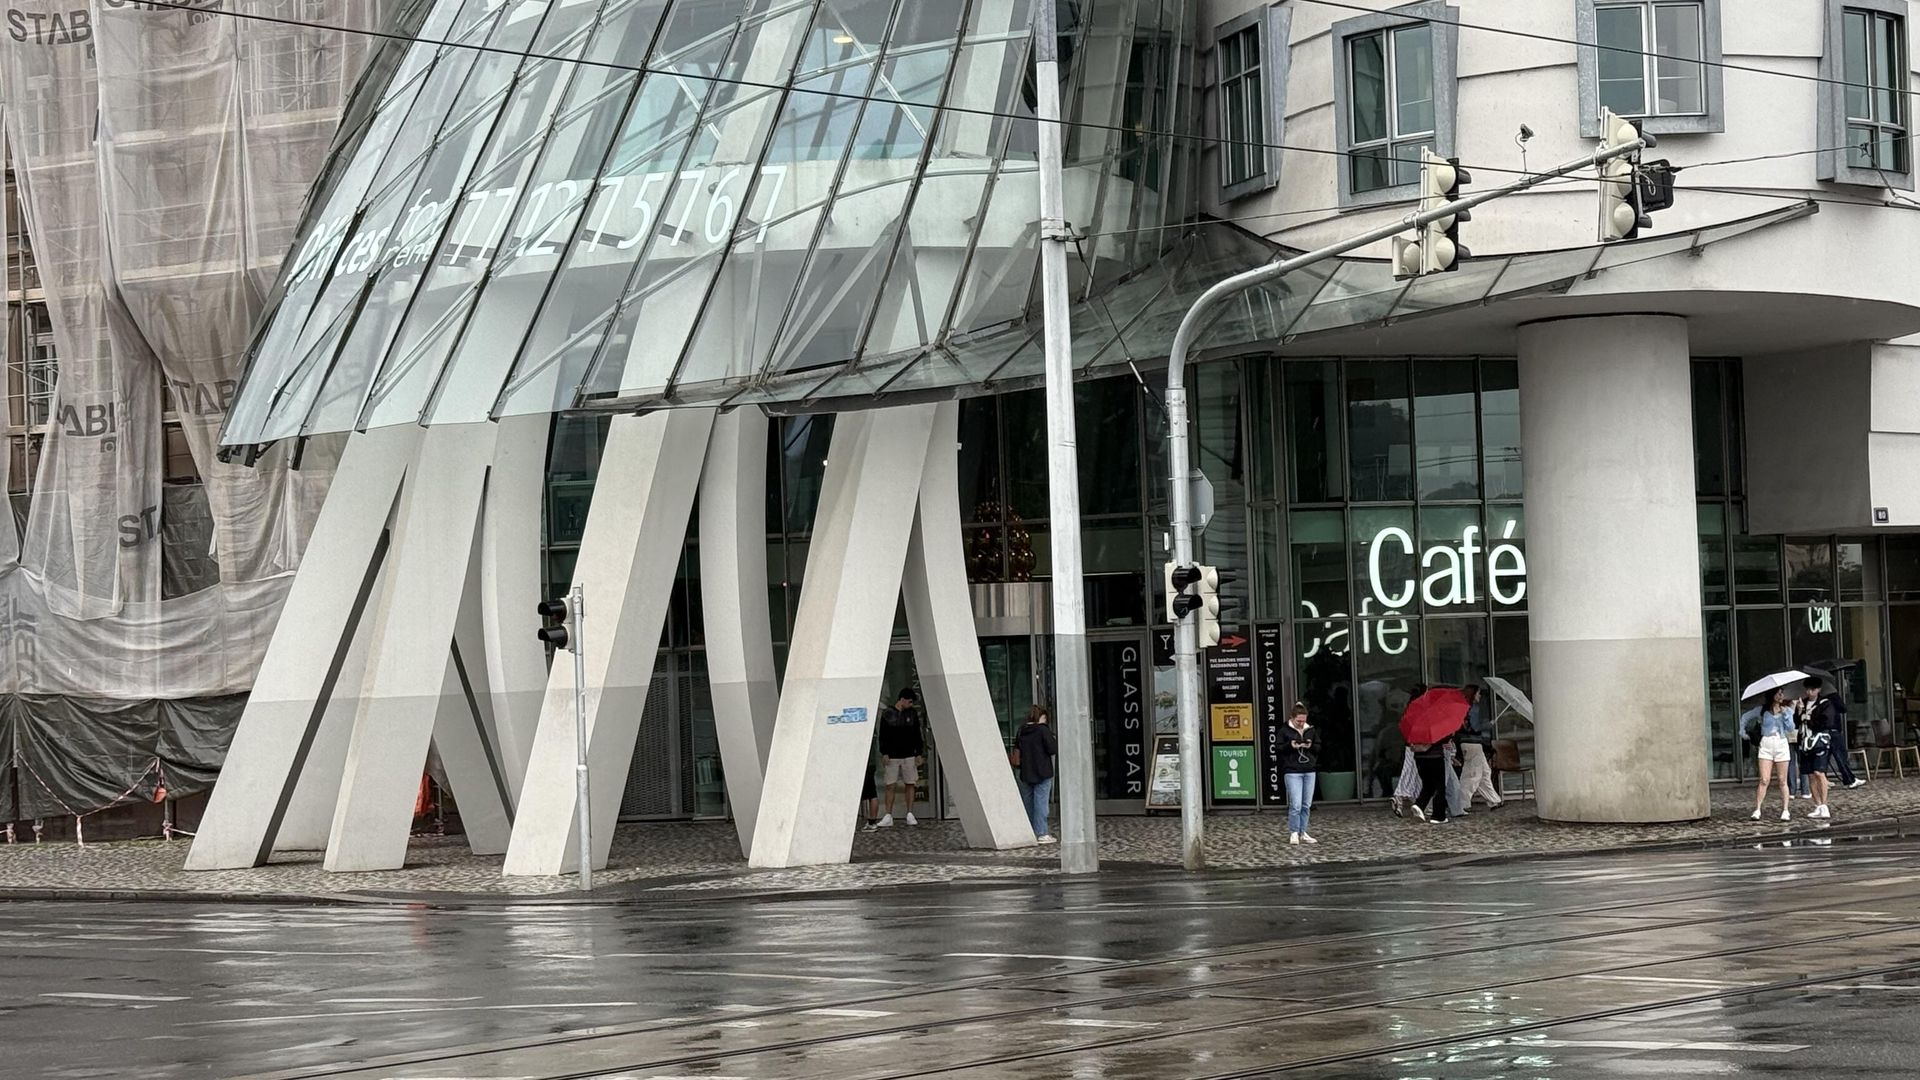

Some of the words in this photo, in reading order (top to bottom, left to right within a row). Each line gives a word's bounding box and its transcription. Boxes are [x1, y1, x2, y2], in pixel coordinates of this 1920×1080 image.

[290, 215, 391, 283] Offces
[117, 506, 162, 548] ST
[1369, 520, 1527, 607] Café
[1121, 646, 1140, 730] GLASS
[1265, 651, 1275, 691] GLASS
[1267, 696, 1276, 721] BAR
[1268, 725, 1277, 762] ROOF
[1125, 742, 1142, 795] BAR
[1269, 766, 1279, 792] TOP
